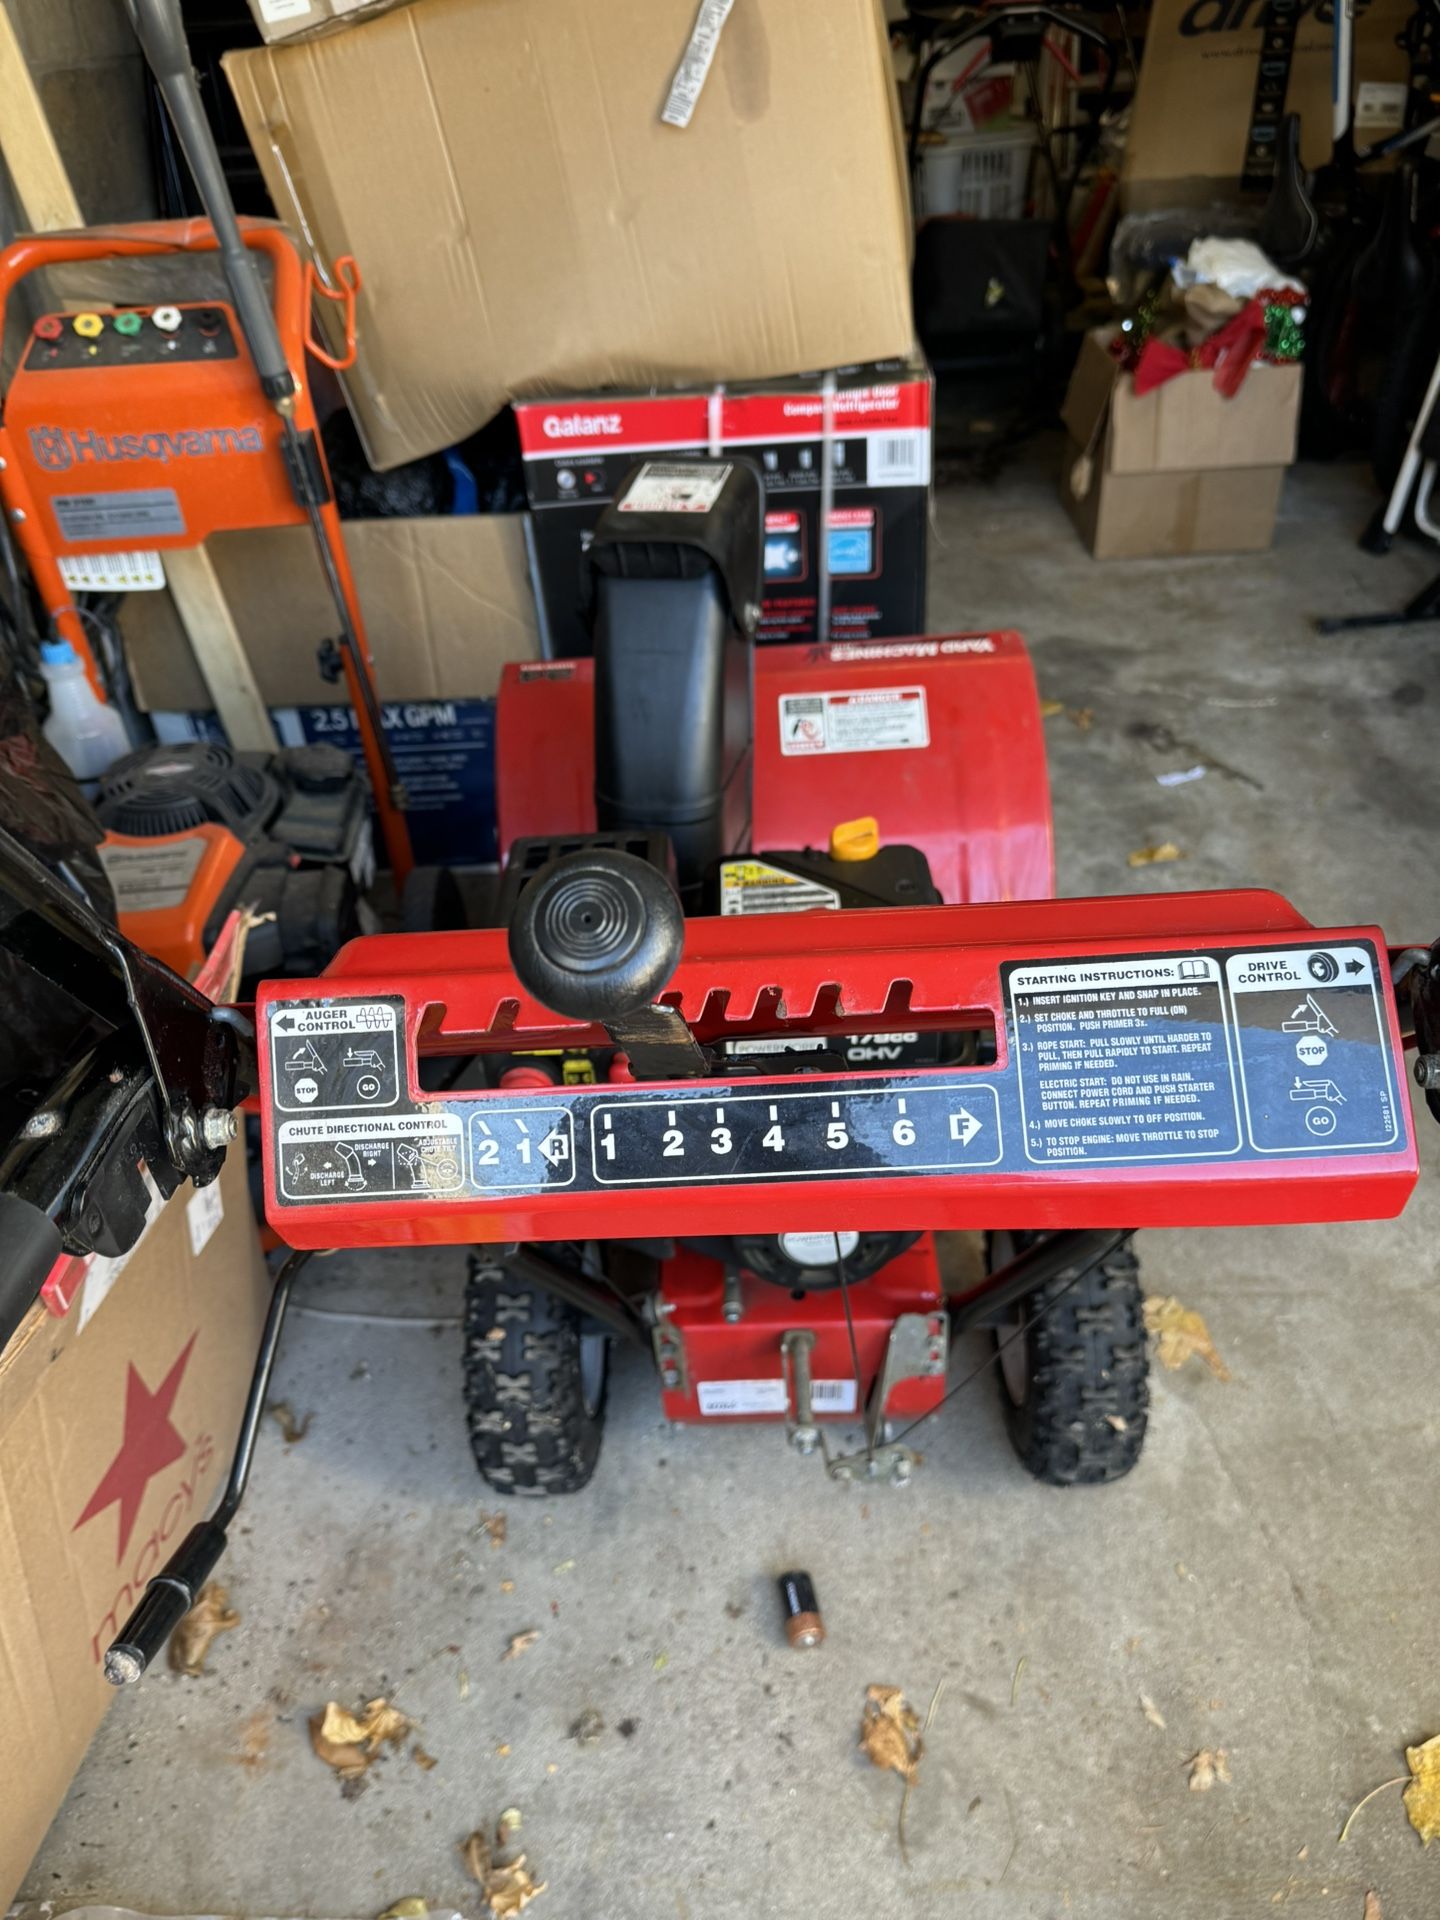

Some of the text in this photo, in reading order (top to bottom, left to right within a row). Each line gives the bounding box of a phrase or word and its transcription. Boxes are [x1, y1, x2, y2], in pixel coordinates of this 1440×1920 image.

[543, 413, 623, 438] Galanz
[69, 426, 264, 464] Husqvarna
[403, 704, 458, 730] GPM
[1248, 960, 1288, 972] DRIVE
[1017, 968, 1175, 986] STARTING INSTRUCTIONS:
[1238, 971, 1301, 983] CONTROL
[1018, 986, 1202, 1007] 1.) INSERT IGNITION KEY AND SNAP IN PLACE.
[305, 1010, 347, 1021] AUGER
[1019, 1005, 1188, 1025] 2.) SET CHOKE AND THROTTLE TO FULL (ON)
[297, 1020, 356, 1032] CONTROL
[1036, 1022, 1076, 1033] POSITION.
[1080, 1021, 1100, 1031] PUSH
[1102, 1018, 1134, 1029] PRIMER
[1022, 1031, 1212, 1052] 3.) ROPE START: PULL SLOWLY UNTIL HARDER TO
[847, 1045, 903, 1062] OHV
[1038, 1042, 1212, 1061] PULL, THEN PULL RAPIDLY TO START. REPEAT
[1298, 1046, 1325, 1056] STOP
[1038, 1059, 1118, 1072] PRIMING IF NEEDED.
[362, 1083, 375, 1091] GO
[1040, 1072, 1195, 1089] ELECTRIC START: DO NOT USE IN RAIN.
[296, 1087, 317, 1095] STOP
[1041, 1082, 1215, 1100] CONNECT POWER CORD AND PUSH STARTER
[1379, 1090, 1388, 1103] SP
[1042, 1094, 1201, 1111] BUTTON. REPEAT PRIMING IF NEEDED.
[289, 1120, 448, 1136] CHUTE DIRECTIONAL CONTROL
[1029, 1111, 1206, 1131] 4.) MOVE CHOKE SLOWLY TO OFF POSITION.
[1312, 1116, 1329, 1125] GO
[418, 1136, 458, 1147] ADJUSTABLE
[600, 1117, 970, 1160] 1 2 3 4 5 6 F
[1030, 1128, 1219, 1148] 5.) TO STOP ENGINE: MOVE THROTTLE TO STOP
[354, 1142, 389, 1151] DISCHARGE
[362, 1150, 382, 1158] RIGHT
[420, 1143, 457, 1153] CHUTE TILT
[478, 1138, 565, 1166] 2 1 R
[1046, 1146, 1088, 1157] POSITION.
[310, 1171, 345, 1180] DISCHARGE
[319, 1179, 336, 1187] LEFT
